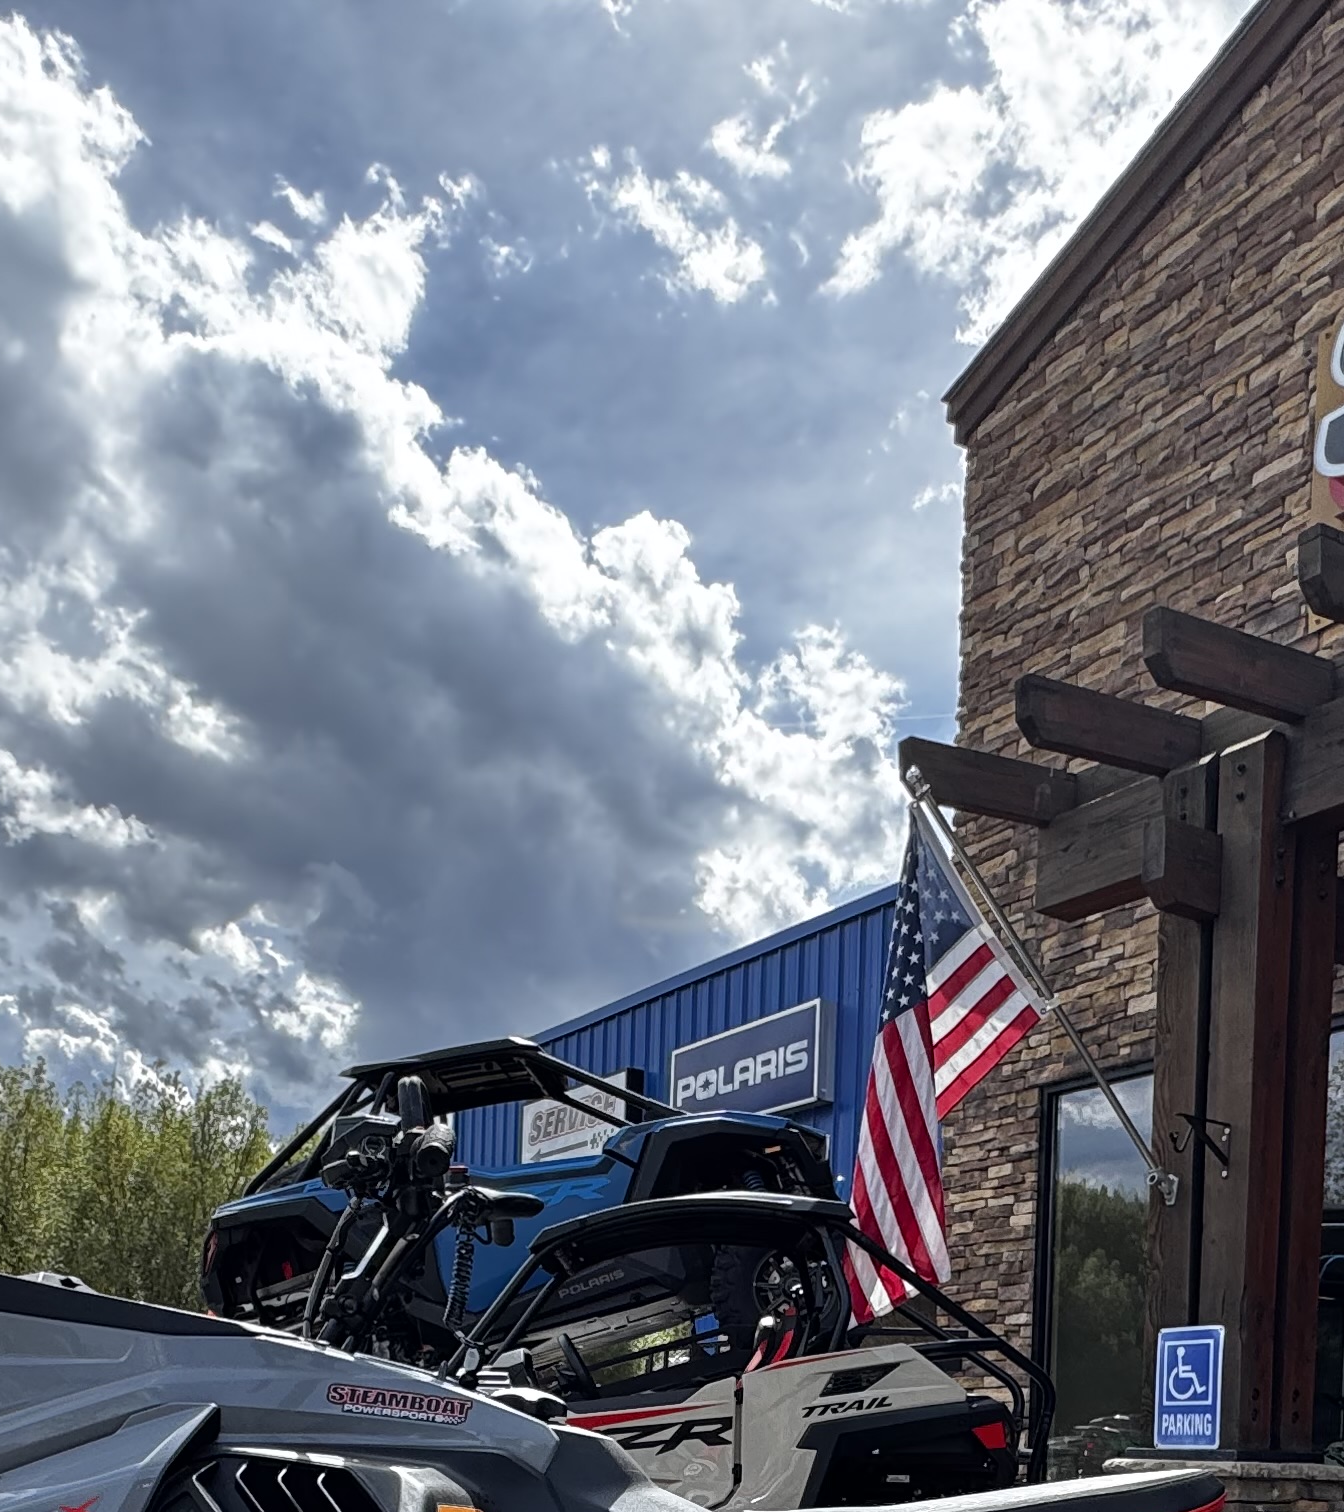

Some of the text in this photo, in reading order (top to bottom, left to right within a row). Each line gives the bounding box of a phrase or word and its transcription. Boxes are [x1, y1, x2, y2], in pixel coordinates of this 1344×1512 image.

[676, 1039, 808, 1108] POLARIS
[558, 1269, 625, 1298] POLARIS
[328, 1385, 472, 1417] STEAMBOAT
[343, 1404, 445, 1423] POWERSPORTS
[802, 1395, 893, 1419] TRAIL
[1161, 1413, 1212, 1436] PARKING
